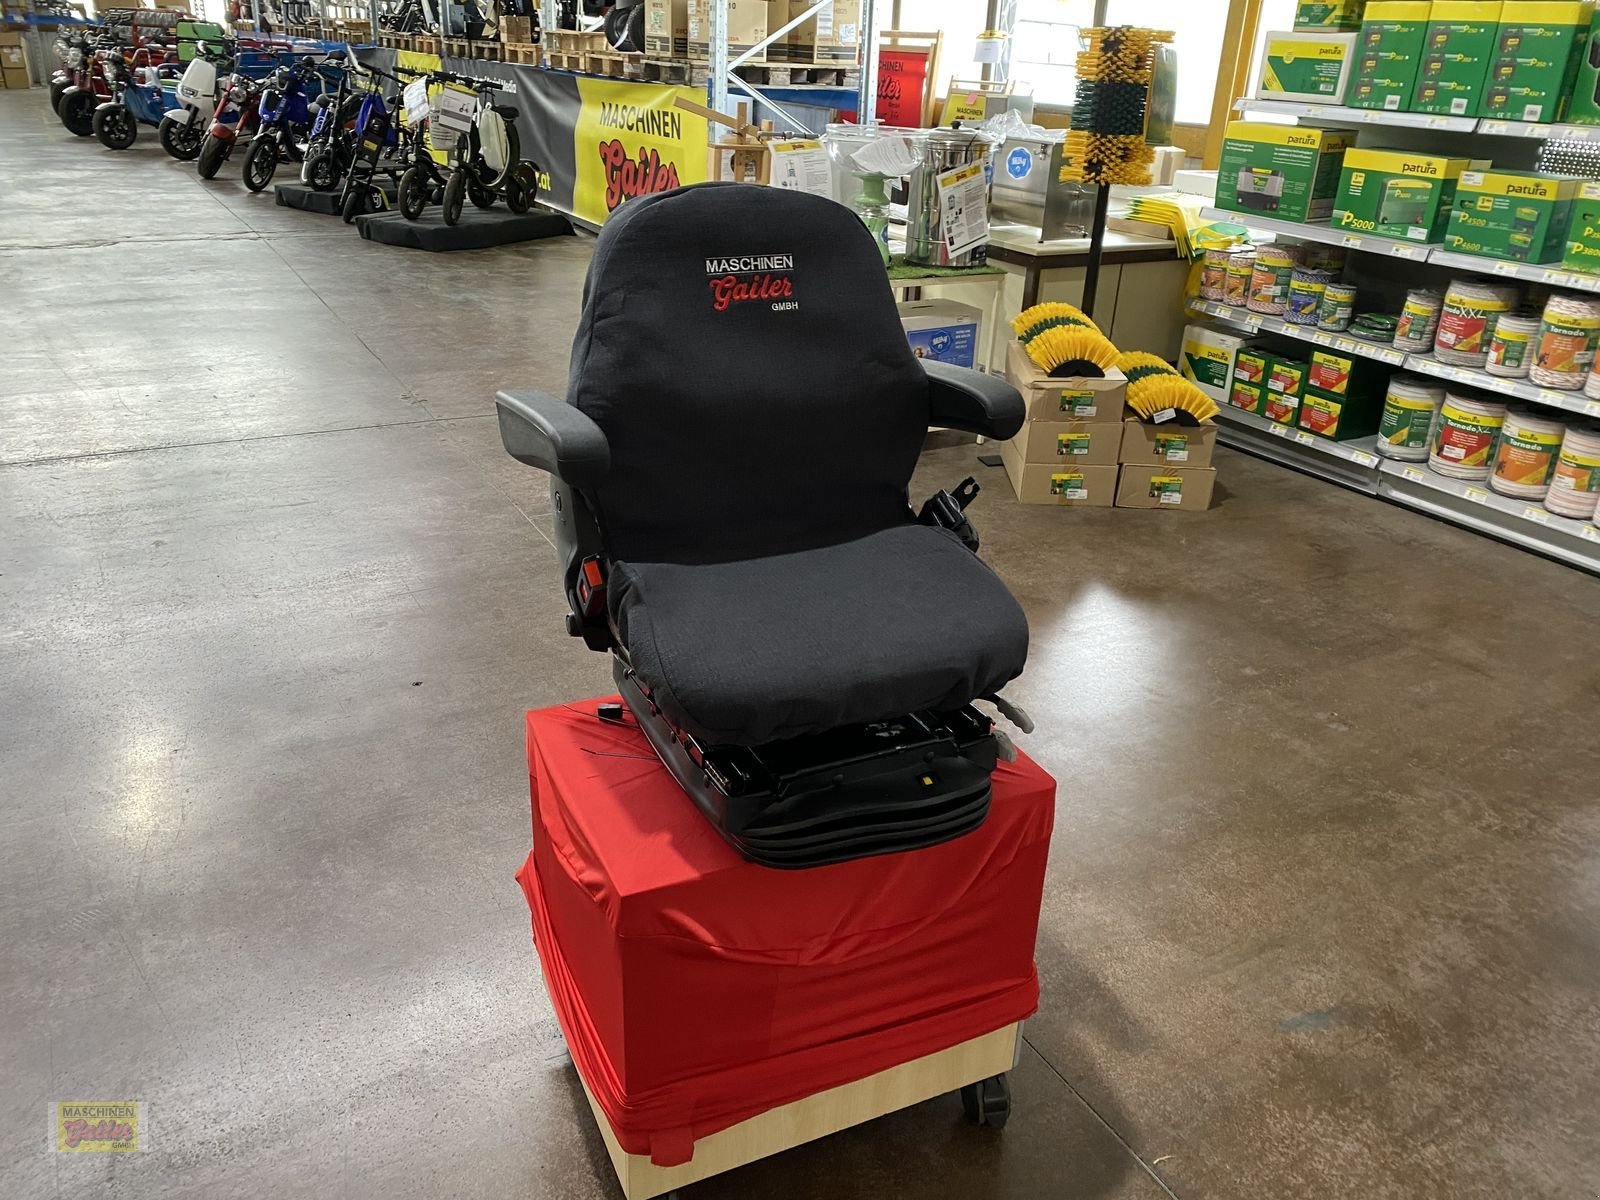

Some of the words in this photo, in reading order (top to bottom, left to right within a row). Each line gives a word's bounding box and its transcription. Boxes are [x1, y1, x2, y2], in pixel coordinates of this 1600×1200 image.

[599, 102, 682, 140] MASCHINEN
[1287, 135, 1317, 146] patura
[599, 138, 682, 213] Gailer
[1402, 162, 1438, 175] patura
[1506, 183, 1548, 197] patura
[1341, 211, 1375, 231] P5000
[1458, 211, 1488, 227] P4500
[1452, 235, 1482, 252] P4600
[705, 255, 794, 273] MASCHINEN
[709, 274, 793, 312] Gailer
[771, 301, 800, 312] GMBH
[1459, 305, 1487, 319] XXL
[1550, 325, 1585, 337] Tornado
[1207, 350, 1230, 363] patura
[1447, 418, 1476, 432] Tornado
[1509, 438, 1543, 451] Tornado
